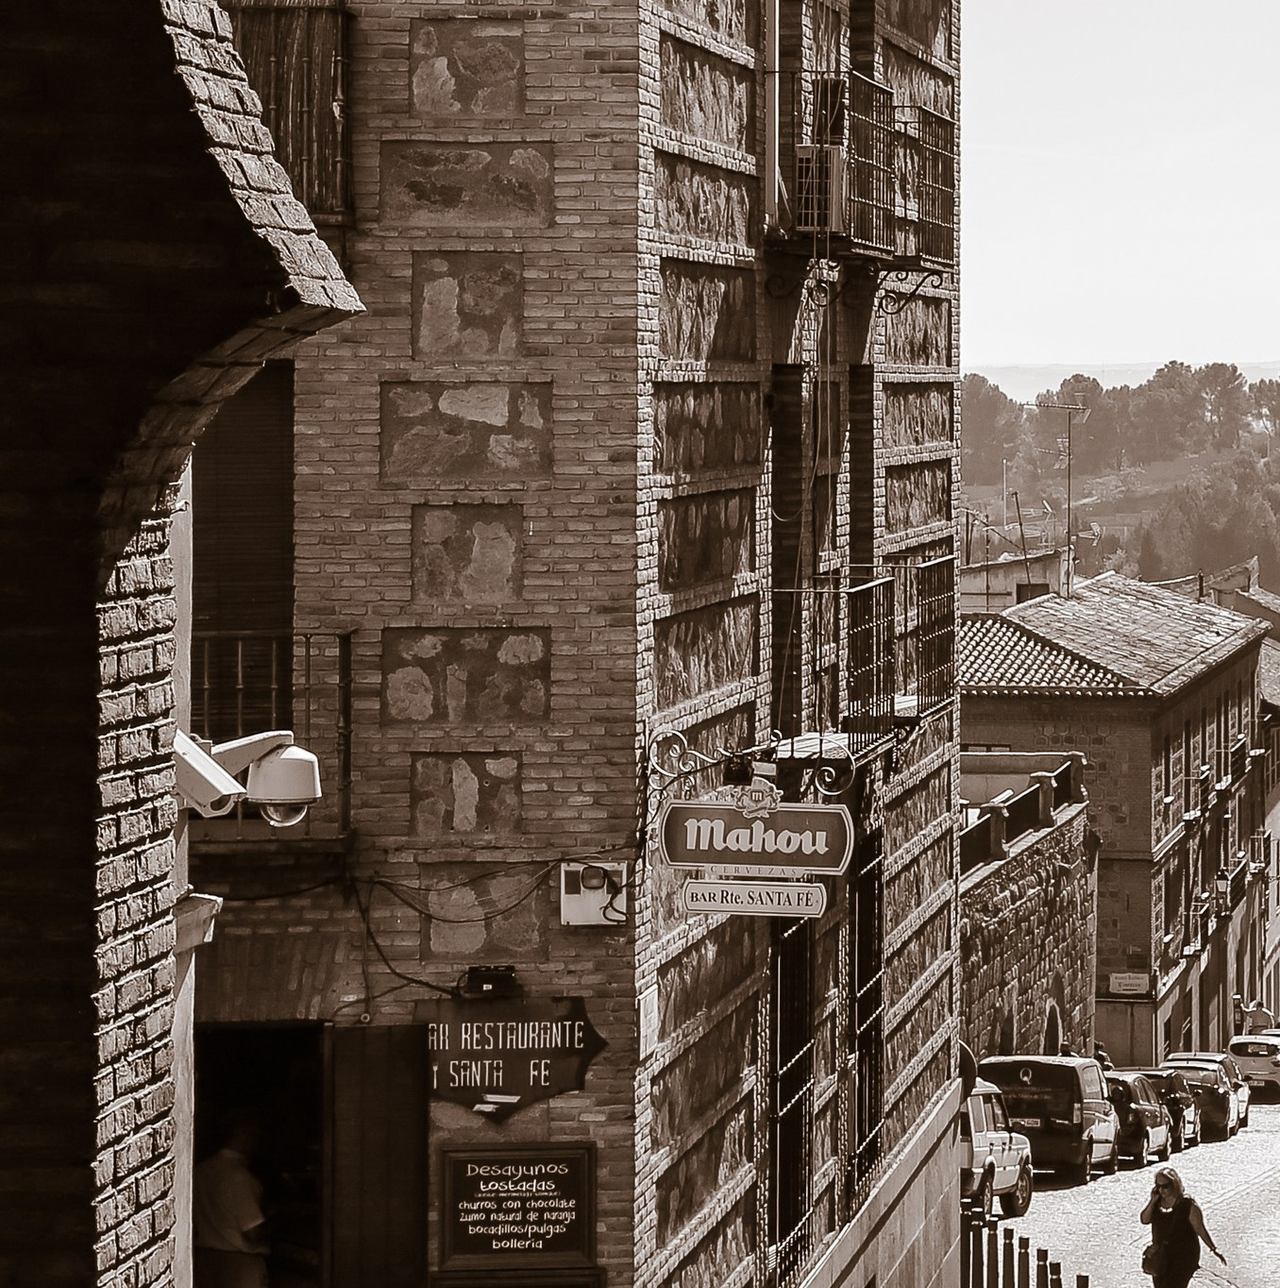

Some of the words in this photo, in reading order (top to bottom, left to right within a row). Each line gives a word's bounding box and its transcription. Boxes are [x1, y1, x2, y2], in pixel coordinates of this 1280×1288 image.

[710, 865, 797, 876] CERVEZAS
[690, 892, 717, 902] BAR
[720, 889, 744, 905] Rte.
[747, 890, 793, 906] SANTA
[796, 890, 814, 907] FÉ
[428, 1023, 449, 1050] AR
[461, 1021, 584, 1050] RESTAURANTE
[449, 1060, 503, 1087] SANTA
[529, 1060, 550, 1086] FE
[466, 1164, 568, 1181] Desayunos
[480, 1179, 555, 1192] tostadas
[459, 1201, 497, 1210] churros
[502, 1200, 521, 1209] con
[526, 1198, 576, 1208] chocolate
[490, 1211, 522, 1221] natural
[526, 1211, 539, 1221] de
[543, 1211, 576, 1224] naranja
